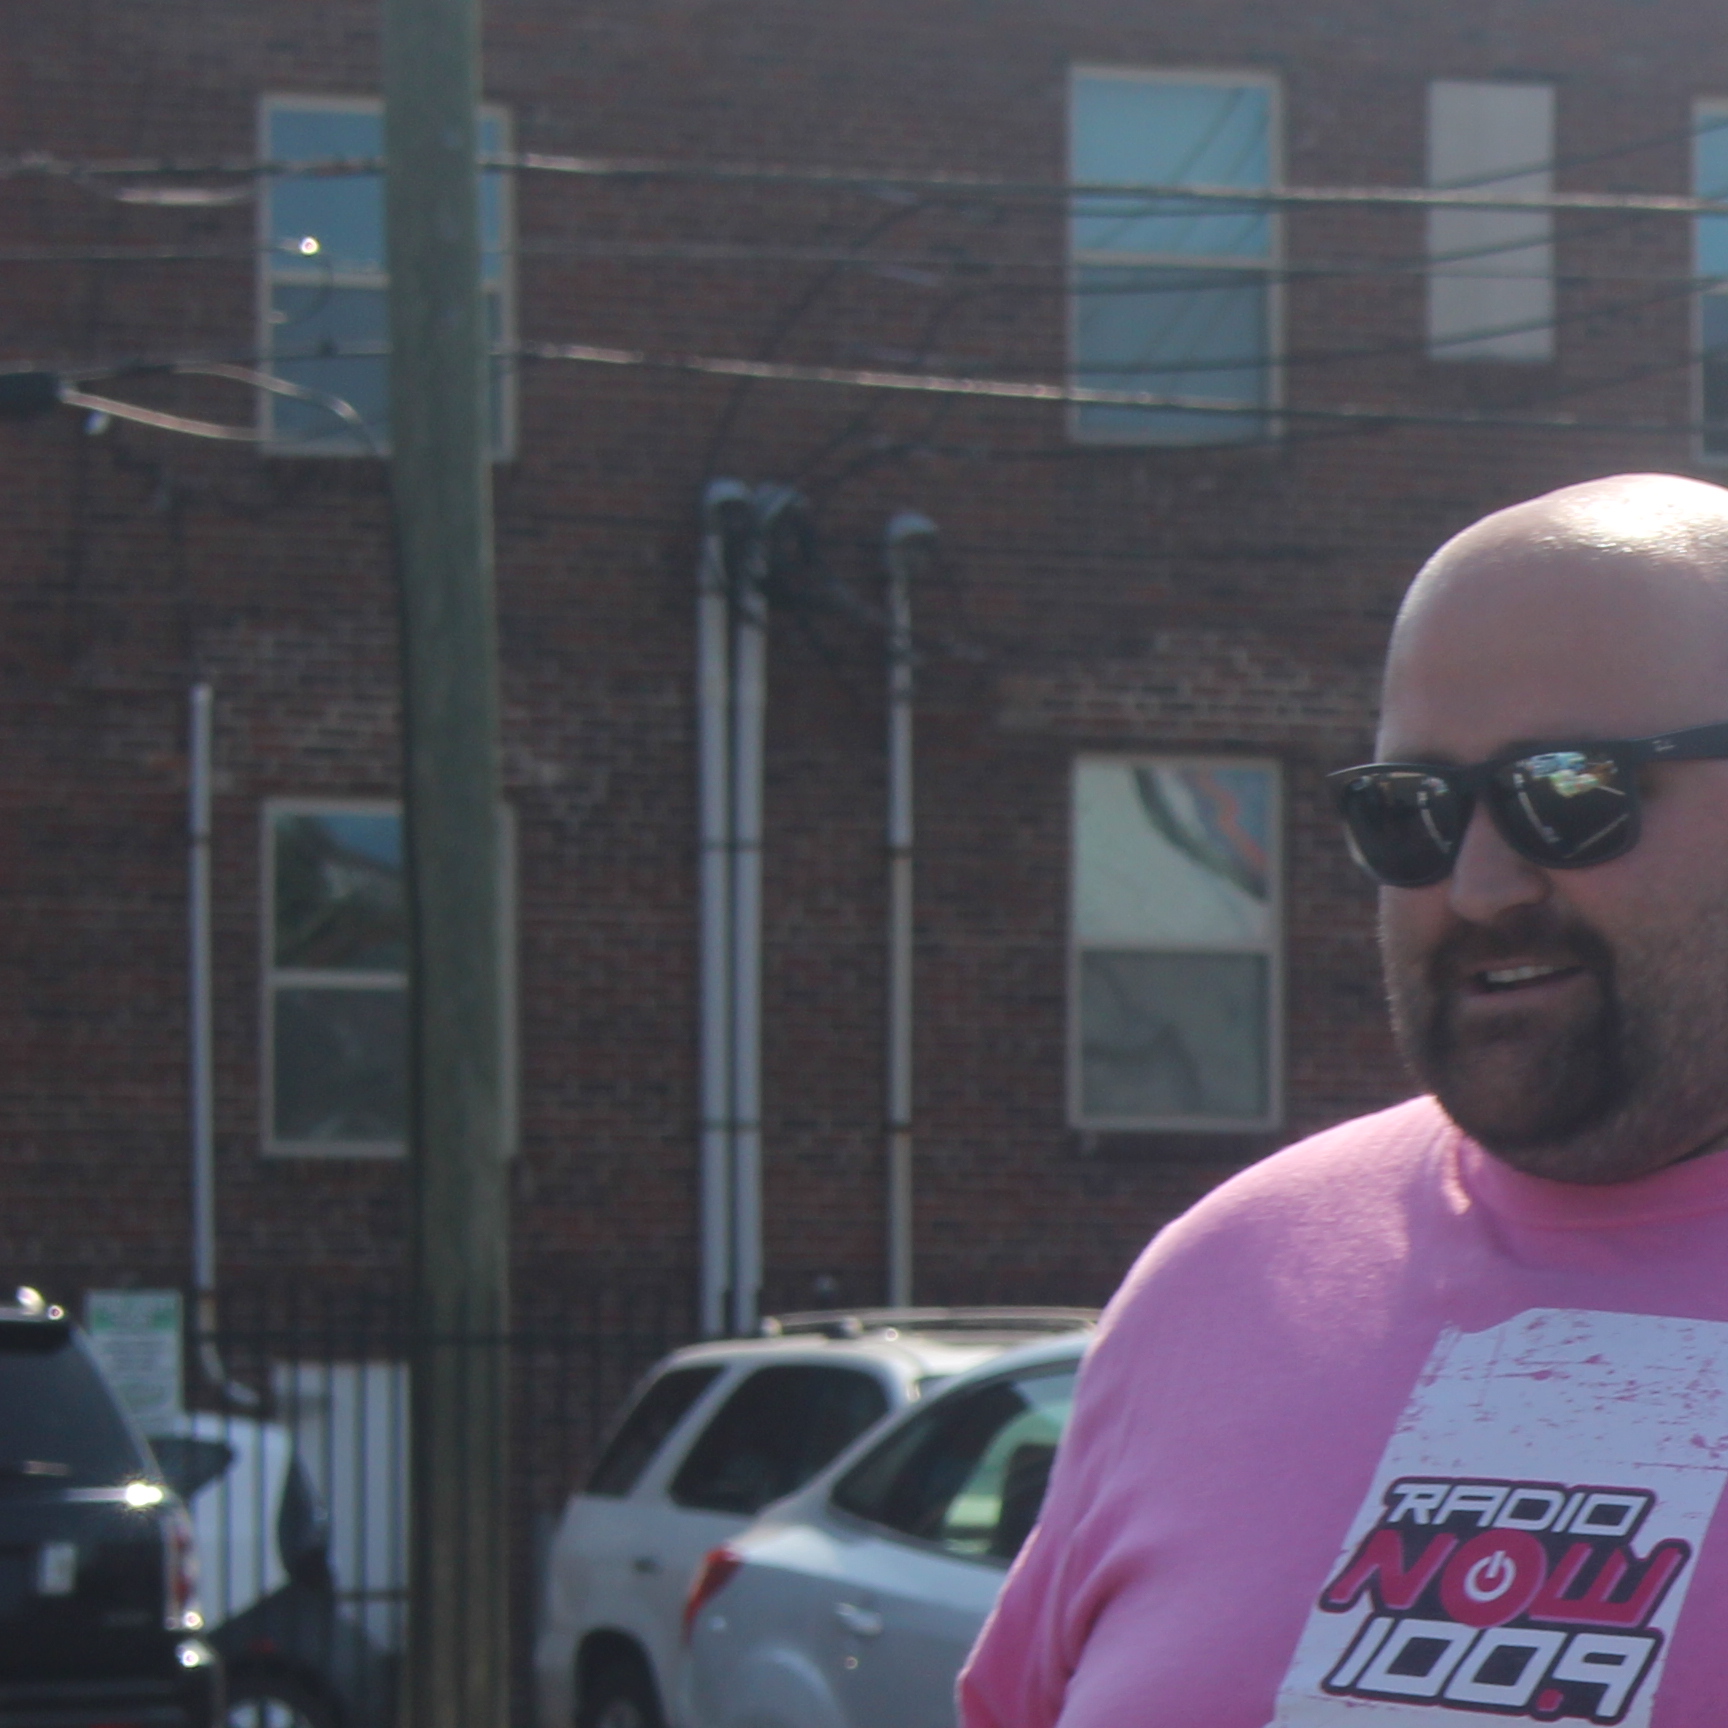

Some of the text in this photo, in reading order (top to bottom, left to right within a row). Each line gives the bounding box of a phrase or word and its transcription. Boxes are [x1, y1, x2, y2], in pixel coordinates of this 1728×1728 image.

[1386, 1481, 1653, 1539] RADIO
[1326, 1527, 1686, 1628] NOW
[1328, 1616, 1658, 1719] 100.9
